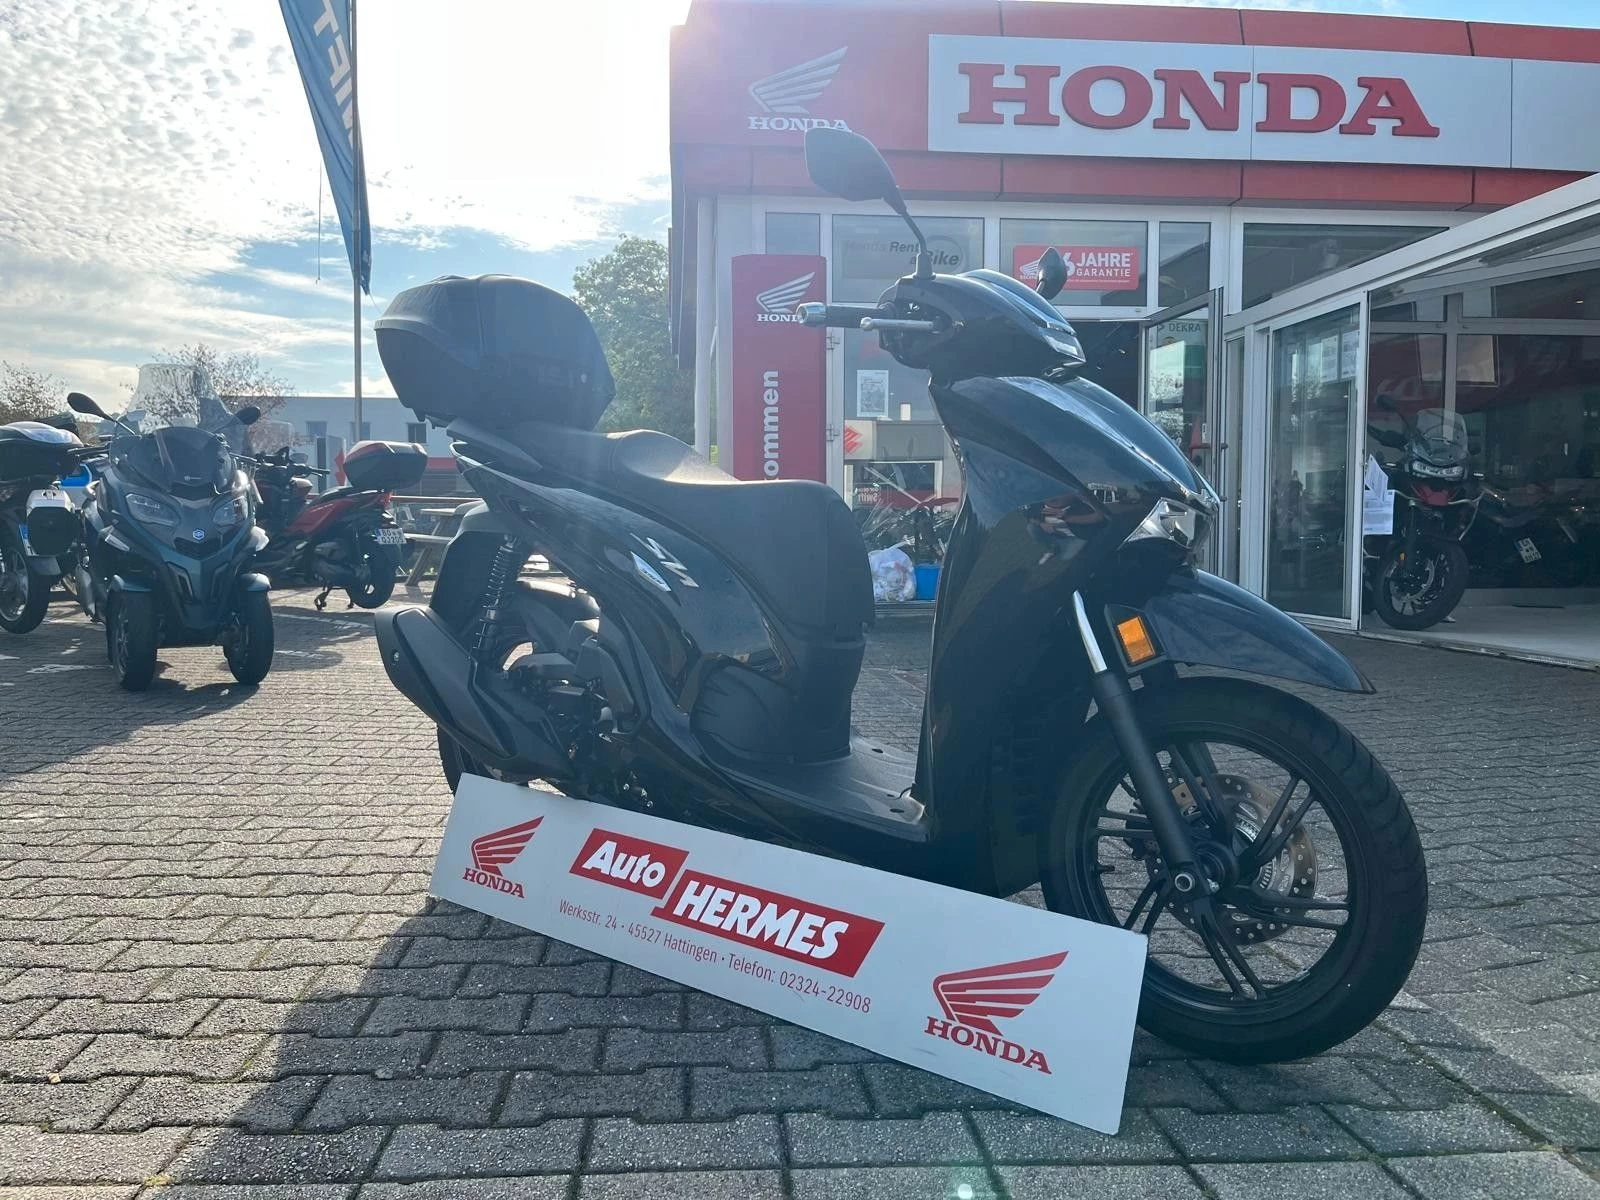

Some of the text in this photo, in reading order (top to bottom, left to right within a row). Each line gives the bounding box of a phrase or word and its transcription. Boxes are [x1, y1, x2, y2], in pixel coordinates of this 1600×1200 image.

[747, 116, 853, 132] HONDA
[957, 62, 1441, 138] HONDA
[1076, 252, 1131, 268] JAHRE
[1076, 268, 1131, 277] GARANTIE
[1168, 322, 1201, 333] DEKRA
[763, 370, 779, 481] ommen
[462, 867, 525, 898] HONDA
[582, 840, 666, 888] Auto
[672, 879, 849, 960] HERMES
[559, 899, 871, 1014] Werksstr. 24 45527 Hattingen Telefon: 02324-22908
[924, 1015, 1052, 1075] HONDA
